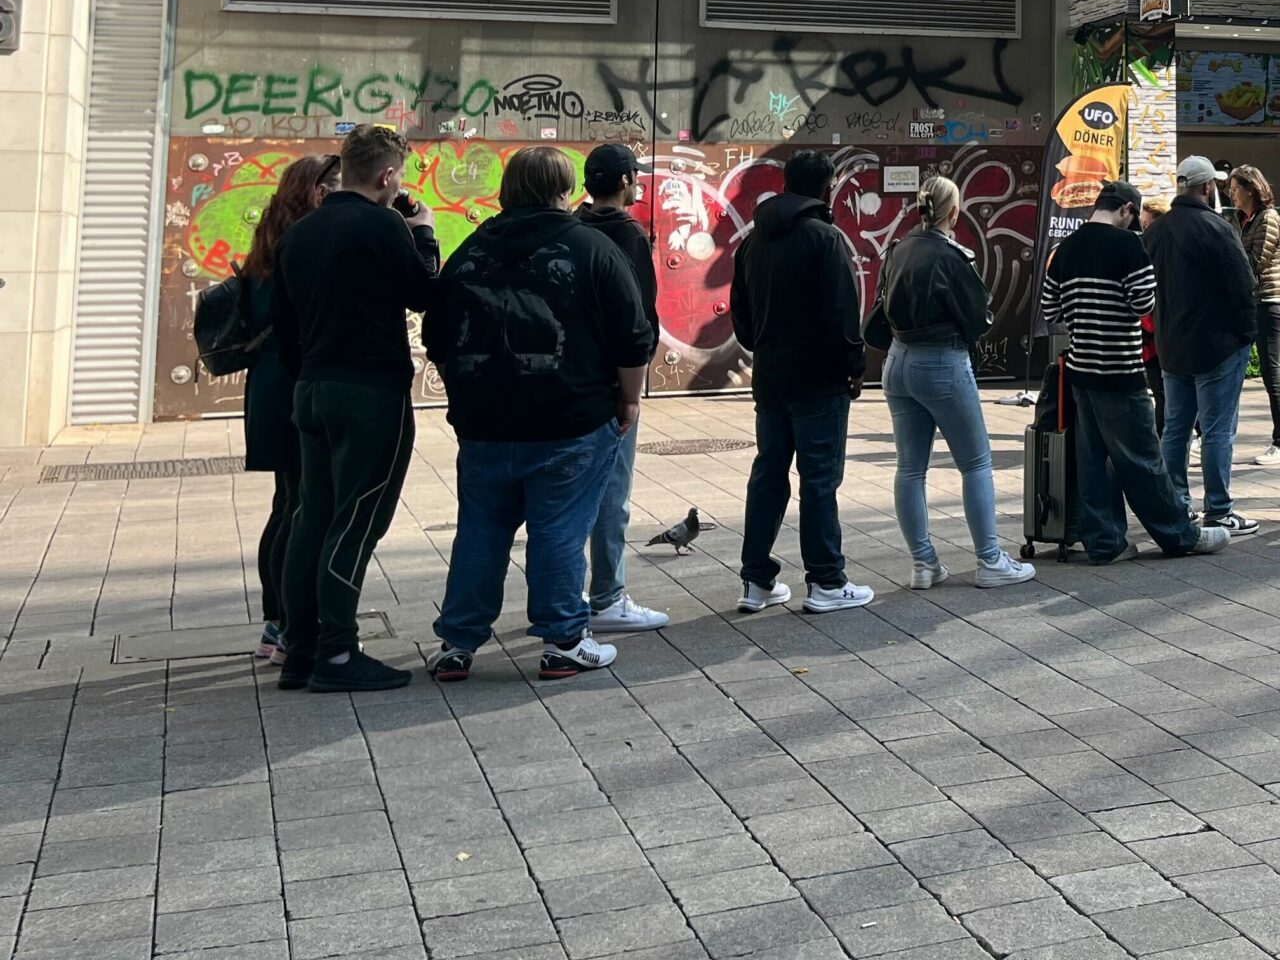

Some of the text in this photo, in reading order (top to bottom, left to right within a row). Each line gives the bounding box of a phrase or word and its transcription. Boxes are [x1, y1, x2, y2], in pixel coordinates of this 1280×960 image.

[1084, 108, 1114, 124] UFO
[910, 123, 934, 133] FROST
[1074, 130, 1114, 147] DÖNER
